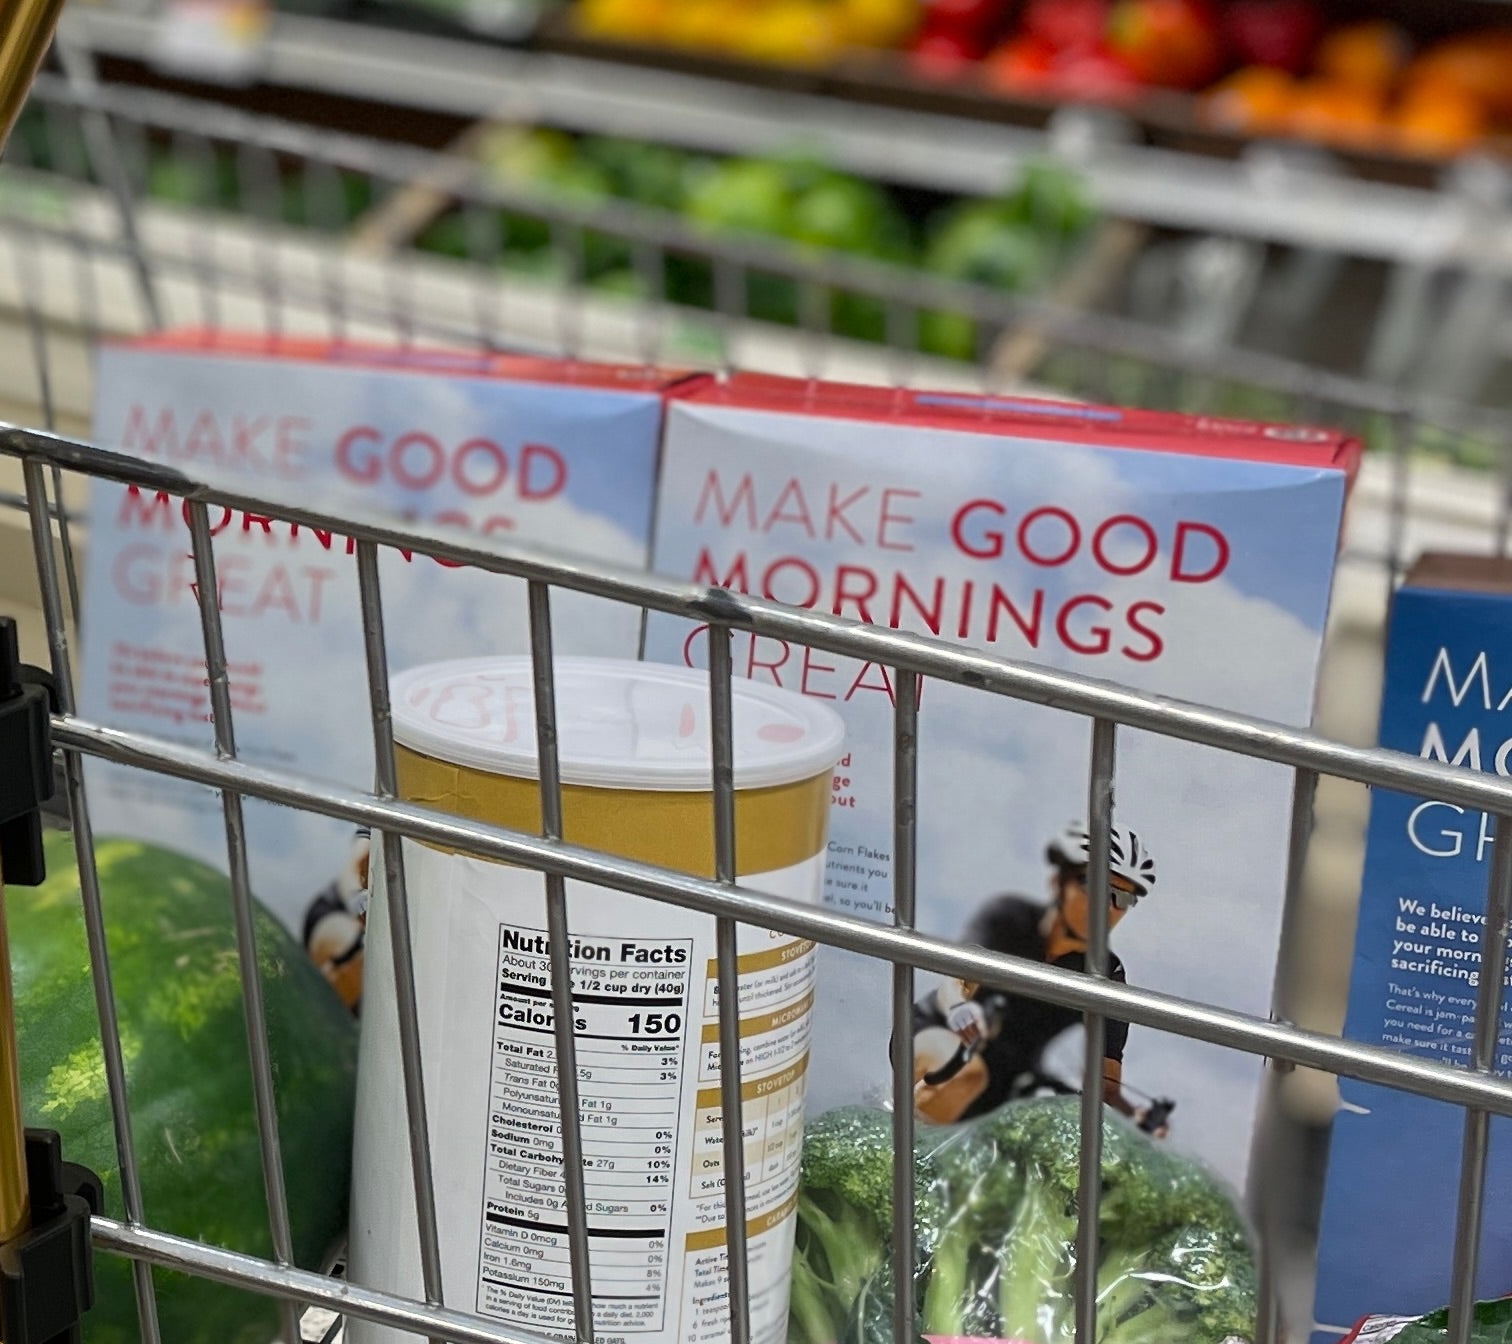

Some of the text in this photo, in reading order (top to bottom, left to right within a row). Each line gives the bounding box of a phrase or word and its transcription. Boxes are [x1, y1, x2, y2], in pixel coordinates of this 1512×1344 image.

[121, 403, 568, 502] MAKE GOOD
[694, 467, 1230, 584] MAKE GOOD
[693, 545, 1165, 662] MORNINGS
[828, 841, 890, 861] Corn Flakes
[826, 860, 887, 879] utrients you
[836, 880, 868, 892] sure it
[840, 898, 882, 912] so you'll
[1399, 897, 1425, 915] We
[1396, 916, 1479, 942] be able to
[503, 929, 687, 963] Nuttion Facts
[1393, 939, 1432, 954] your
[502, 955, 536, 970] About
[570, 966, 606, 979] rvings
[610, 970, 629, 980] per
[632, 969, 686, 980] container
[1391, 957, 1479, 986] sacrificing
[501, 968, 684, 995] Serving 1/2 cup dry (40g)
[500, 993, 530, 1004] Amount
[1388, 983, 1420, 998] That's
[1423, 991, 1446, 1004] why
[499, 1004, 681, 1034] Calors 150
[1386, 1000, 1433, 1016] Cereal is
[1384, 1018, 1453, 1036] you need for
[632, 1044, 652, 1053] Daily
[1383, 1033, 1447, 1051] make sure it
[497, 1041, 678, 1066] Total Fat 3%
[505, 1058, 550, 1074] Saturated
[505, 1073, 547, 1087] Trans Fat
[503, 1087, 612, 1110] Polyunsatur Fat 1g
[493, 1115, 673, 1139] Cholesterol 0%
[588, 1114, 617, 1125] Fat 1g
[491, 1129, 671, 1154] Sodium 0mg 0%
[491, 1144, 670, 1169] Total Carbohyte 27g 10%
[499, 1160, 530, 1176] Dietary
[534, 1168, 557, 1178] Fiber
[498, 1174, 555, 1193] Total Sugars
[487, 1202, 539, 1220] Protein 5g
[506, 1191, 543, 1205] Includes
[547, 1198, 558, 1209] 0g
[595, 1203, 629, 1213] Sugars
[485, 1223, 664, 1249] Vitamin D 0mcg 0%
[484, 1237, 662, 1263] Calcium 0mg 0%
[483, 1252, 661, 1278] Iron 1.6mg 8%
[483, 1267, 564, 1290] Potassium 150mg
